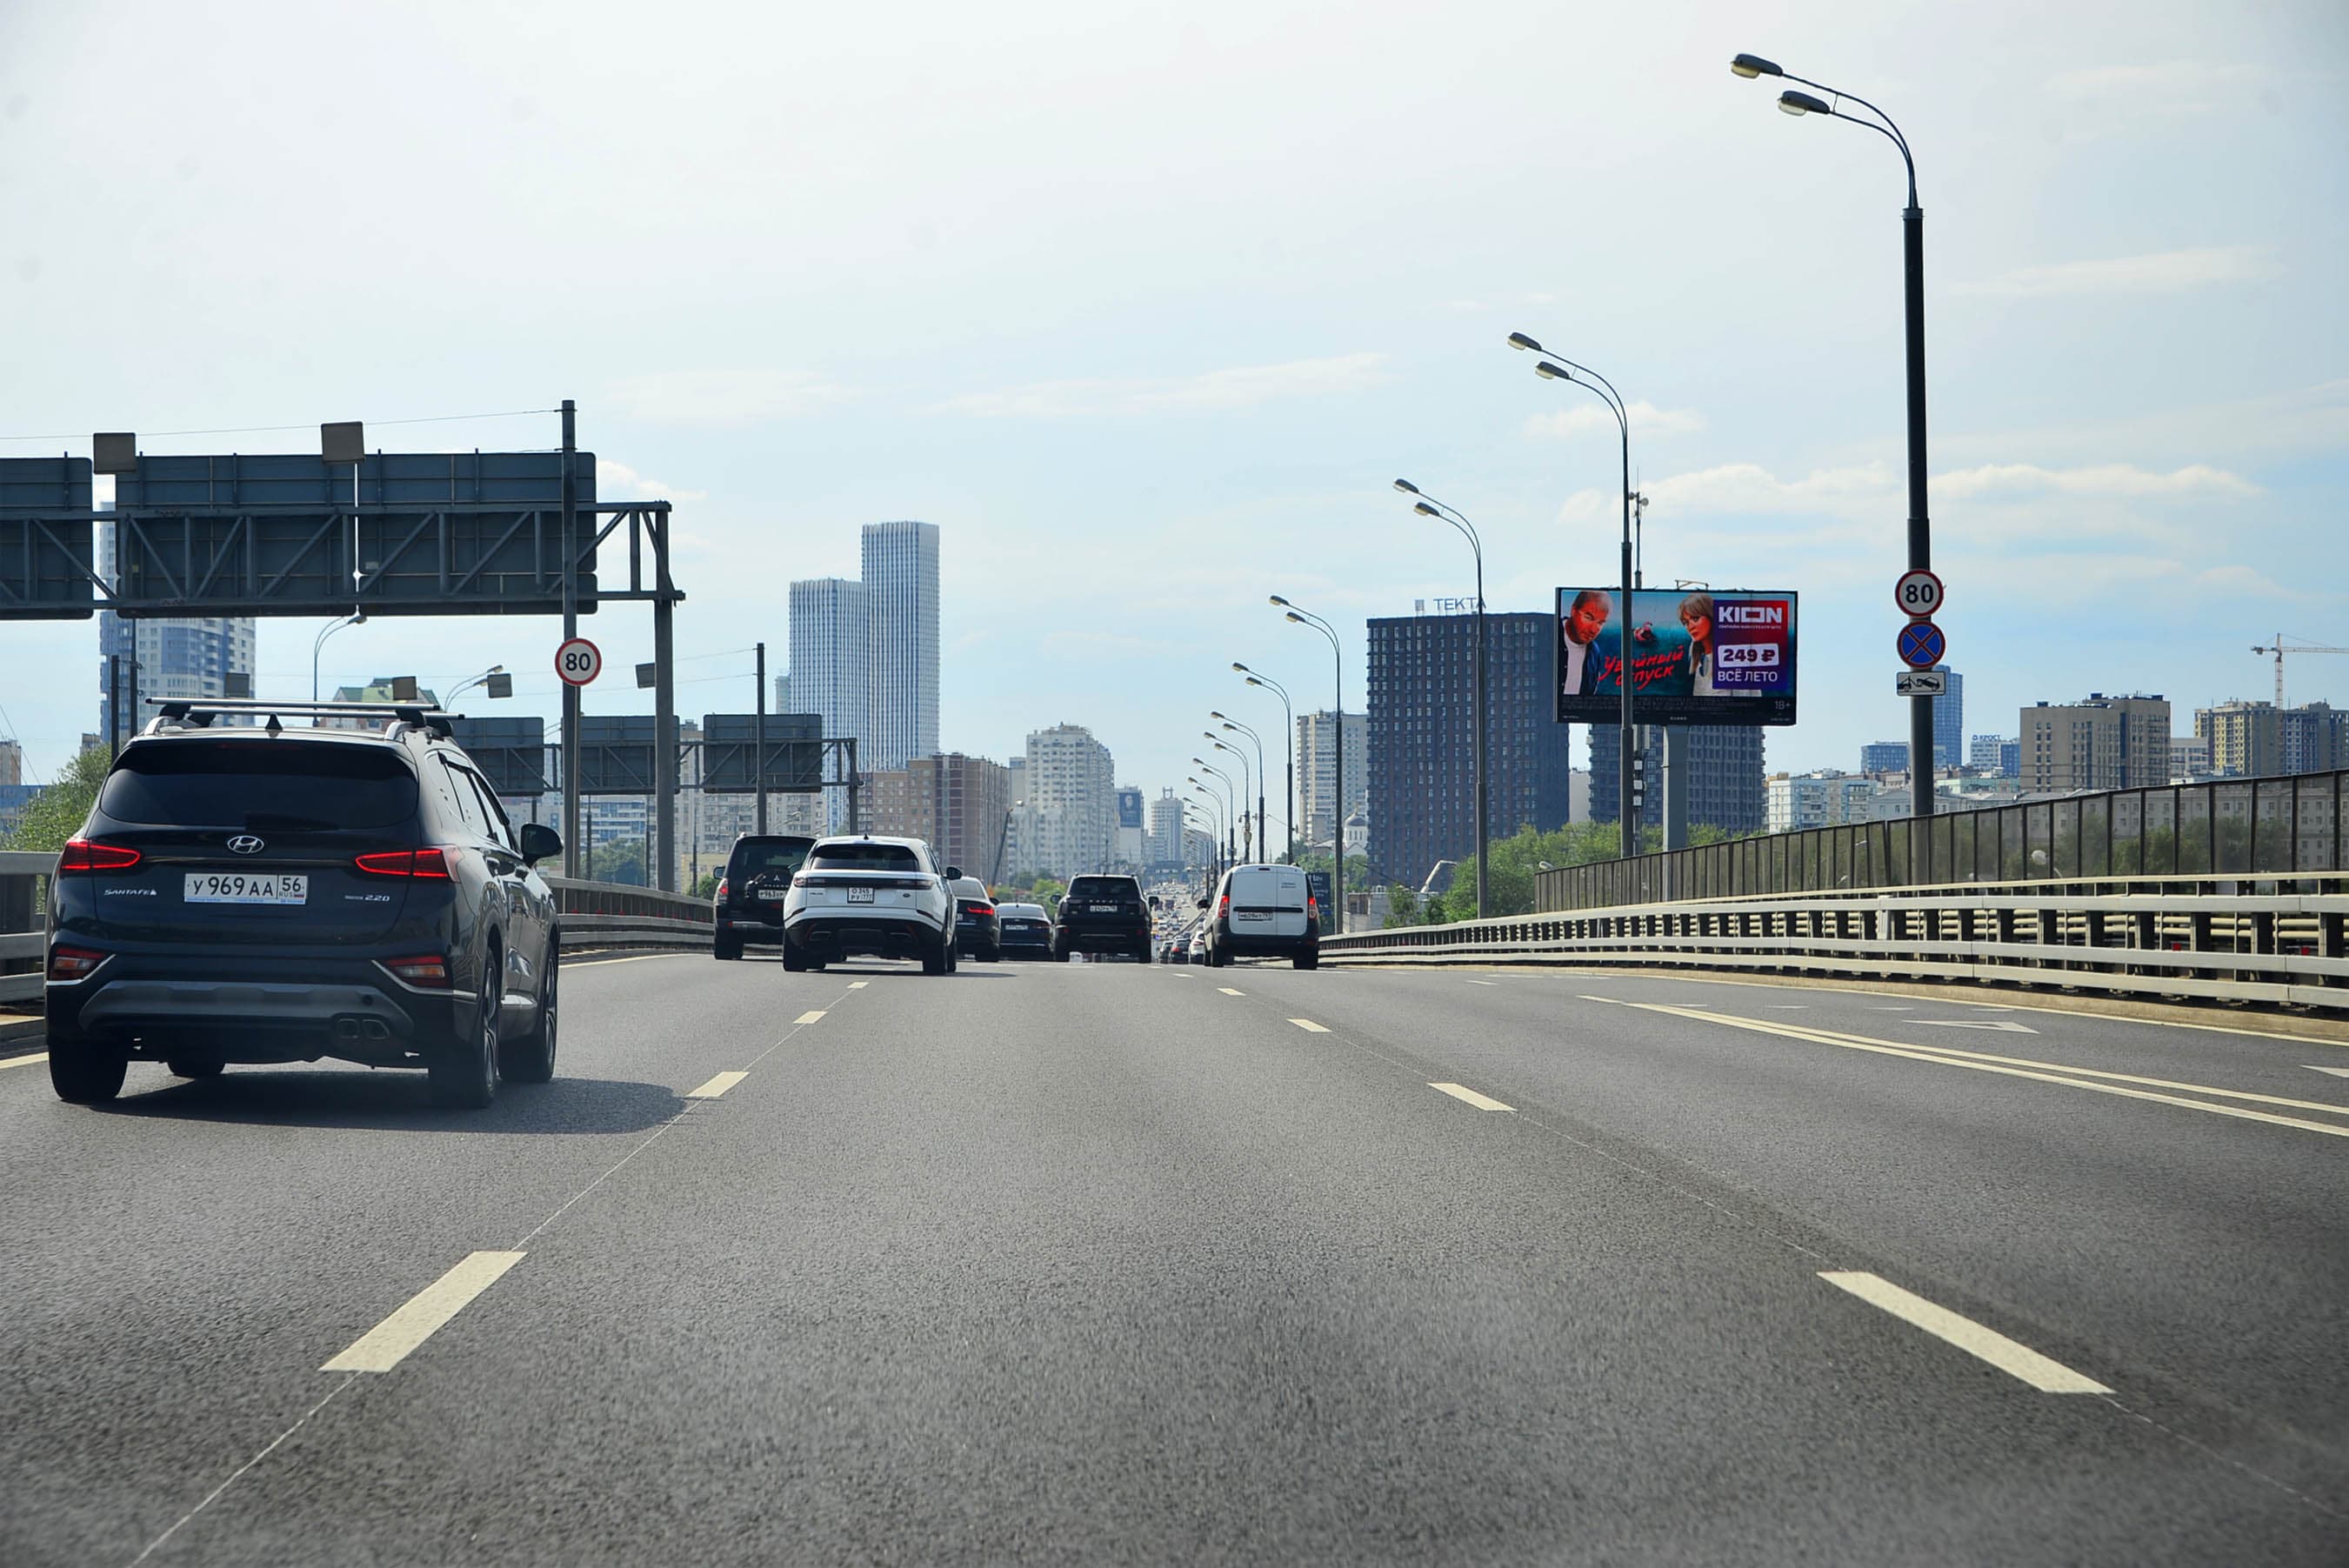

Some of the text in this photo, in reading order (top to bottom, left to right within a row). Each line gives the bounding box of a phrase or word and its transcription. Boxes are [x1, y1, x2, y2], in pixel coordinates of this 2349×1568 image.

[1905, 584, 1933, 604] 80
[1718, 606, 1782, 624] KION
[565, 652, 591, 671] 80
[1723, 649, 1758, 663] 249
[1718, 668, 1778, 683] ВСЁ ЛЕТО
[1774, 700, 1791, 711] 18+
[281, 877, 302, 892] 56
